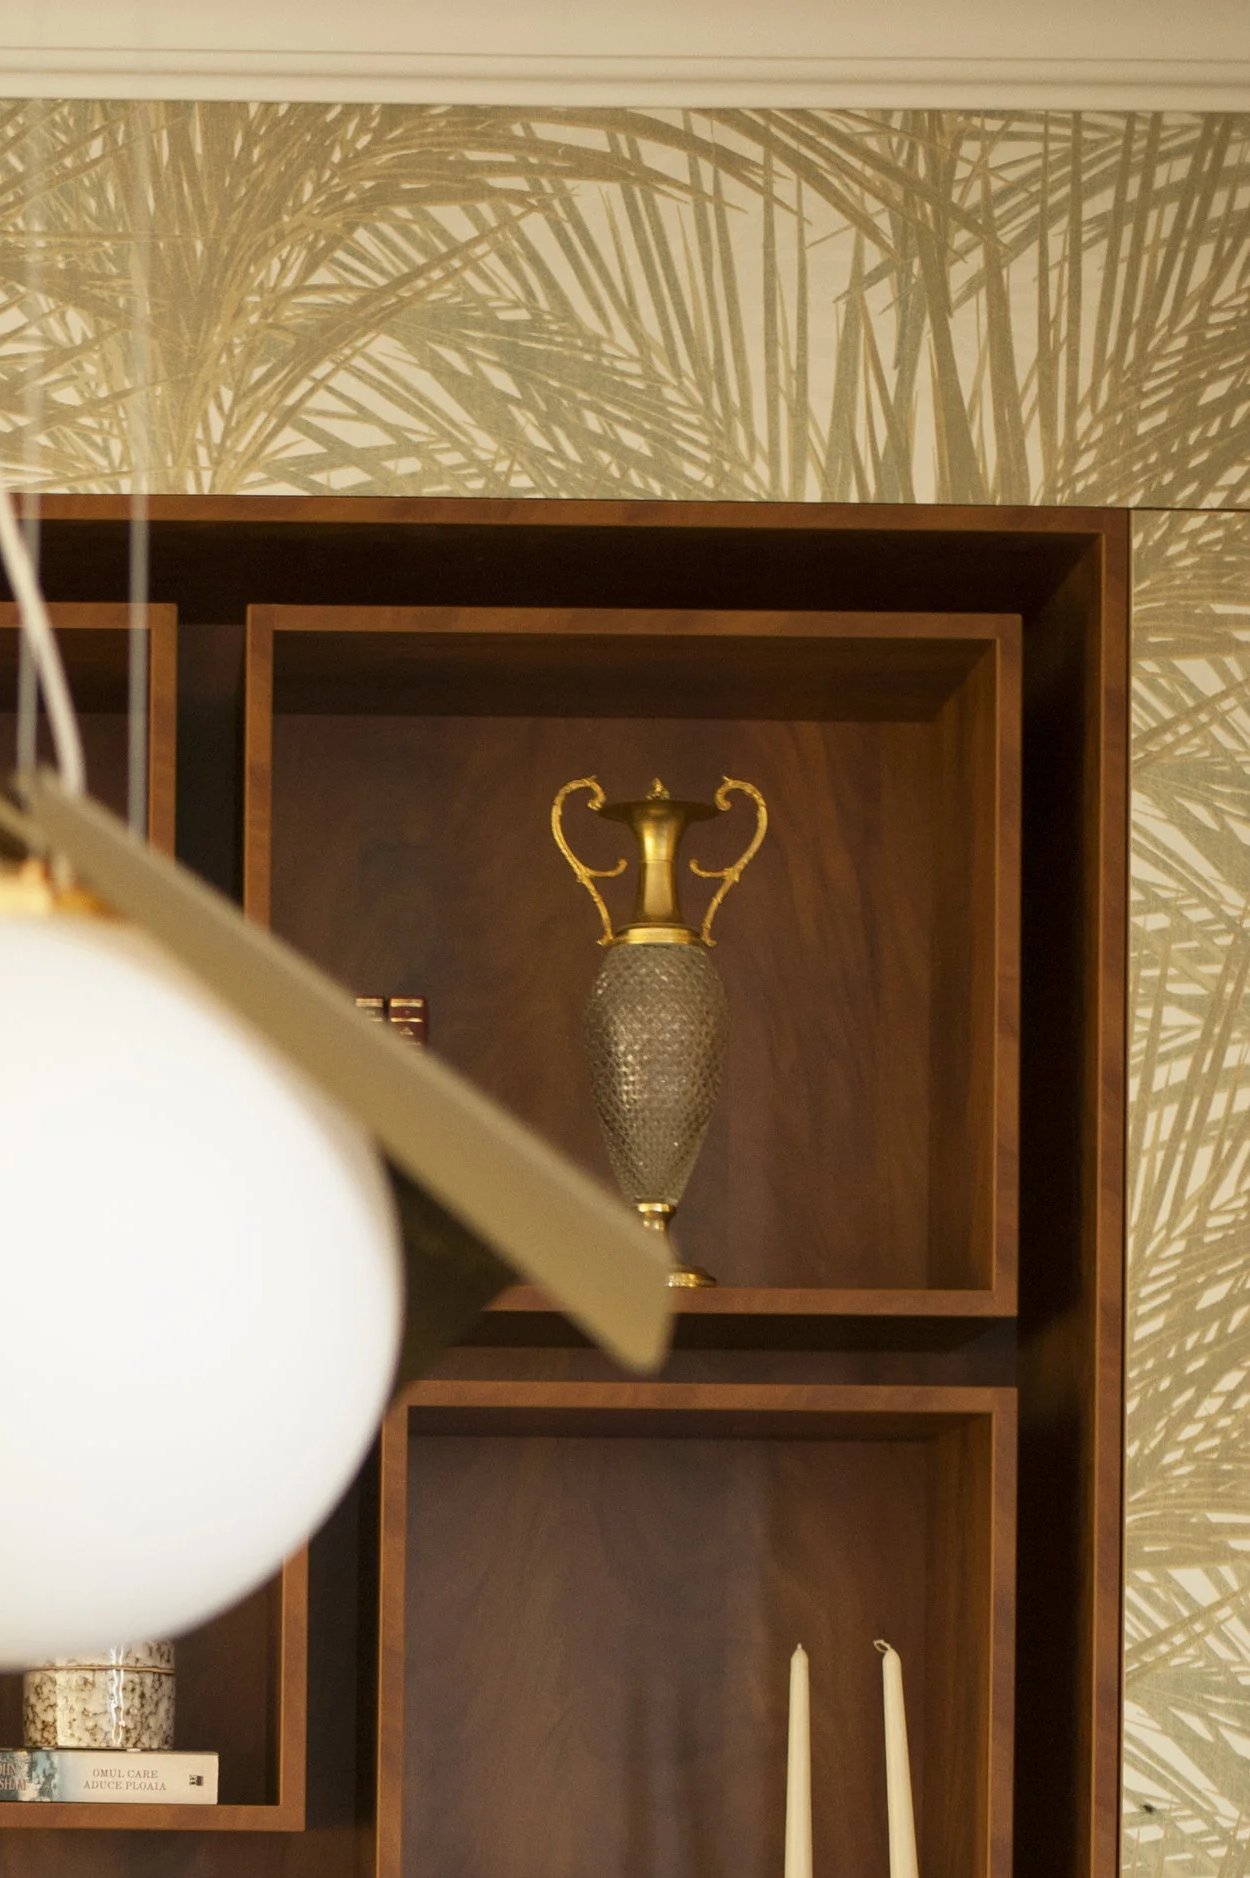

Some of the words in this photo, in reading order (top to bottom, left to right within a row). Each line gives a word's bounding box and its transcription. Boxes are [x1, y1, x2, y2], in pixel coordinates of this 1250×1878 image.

[92, 1768, 124, 1779] OMUL
[127, 1769, 158, 1779] CARE
[83, 1780, 122, 1791] ADUCE
[125, 1781, 167, 1791] PLOAIA
